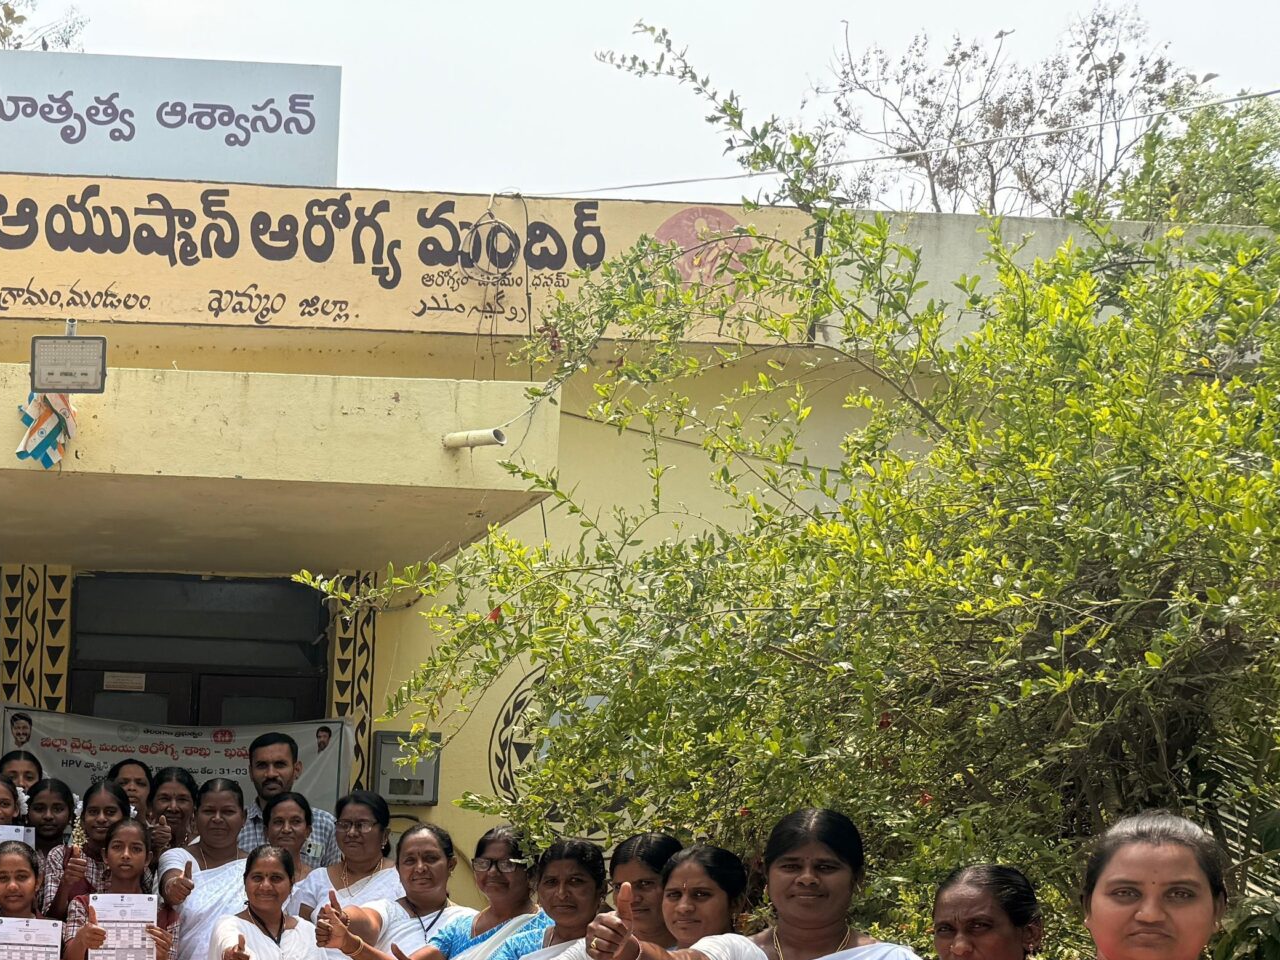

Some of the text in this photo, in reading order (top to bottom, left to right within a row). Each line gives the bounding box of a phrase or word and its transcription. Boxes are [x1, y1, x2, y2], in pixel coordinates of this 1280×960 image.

[156, 93, 316, 147] ఆశ్వాసన్
[250, 192, 402, 290] ఆరోగ్య
[417, 200, 606, 272] మందిర్
[207, 283, 286, 324] ఖమ్మం
[61, 759, 82, 768] HPV
